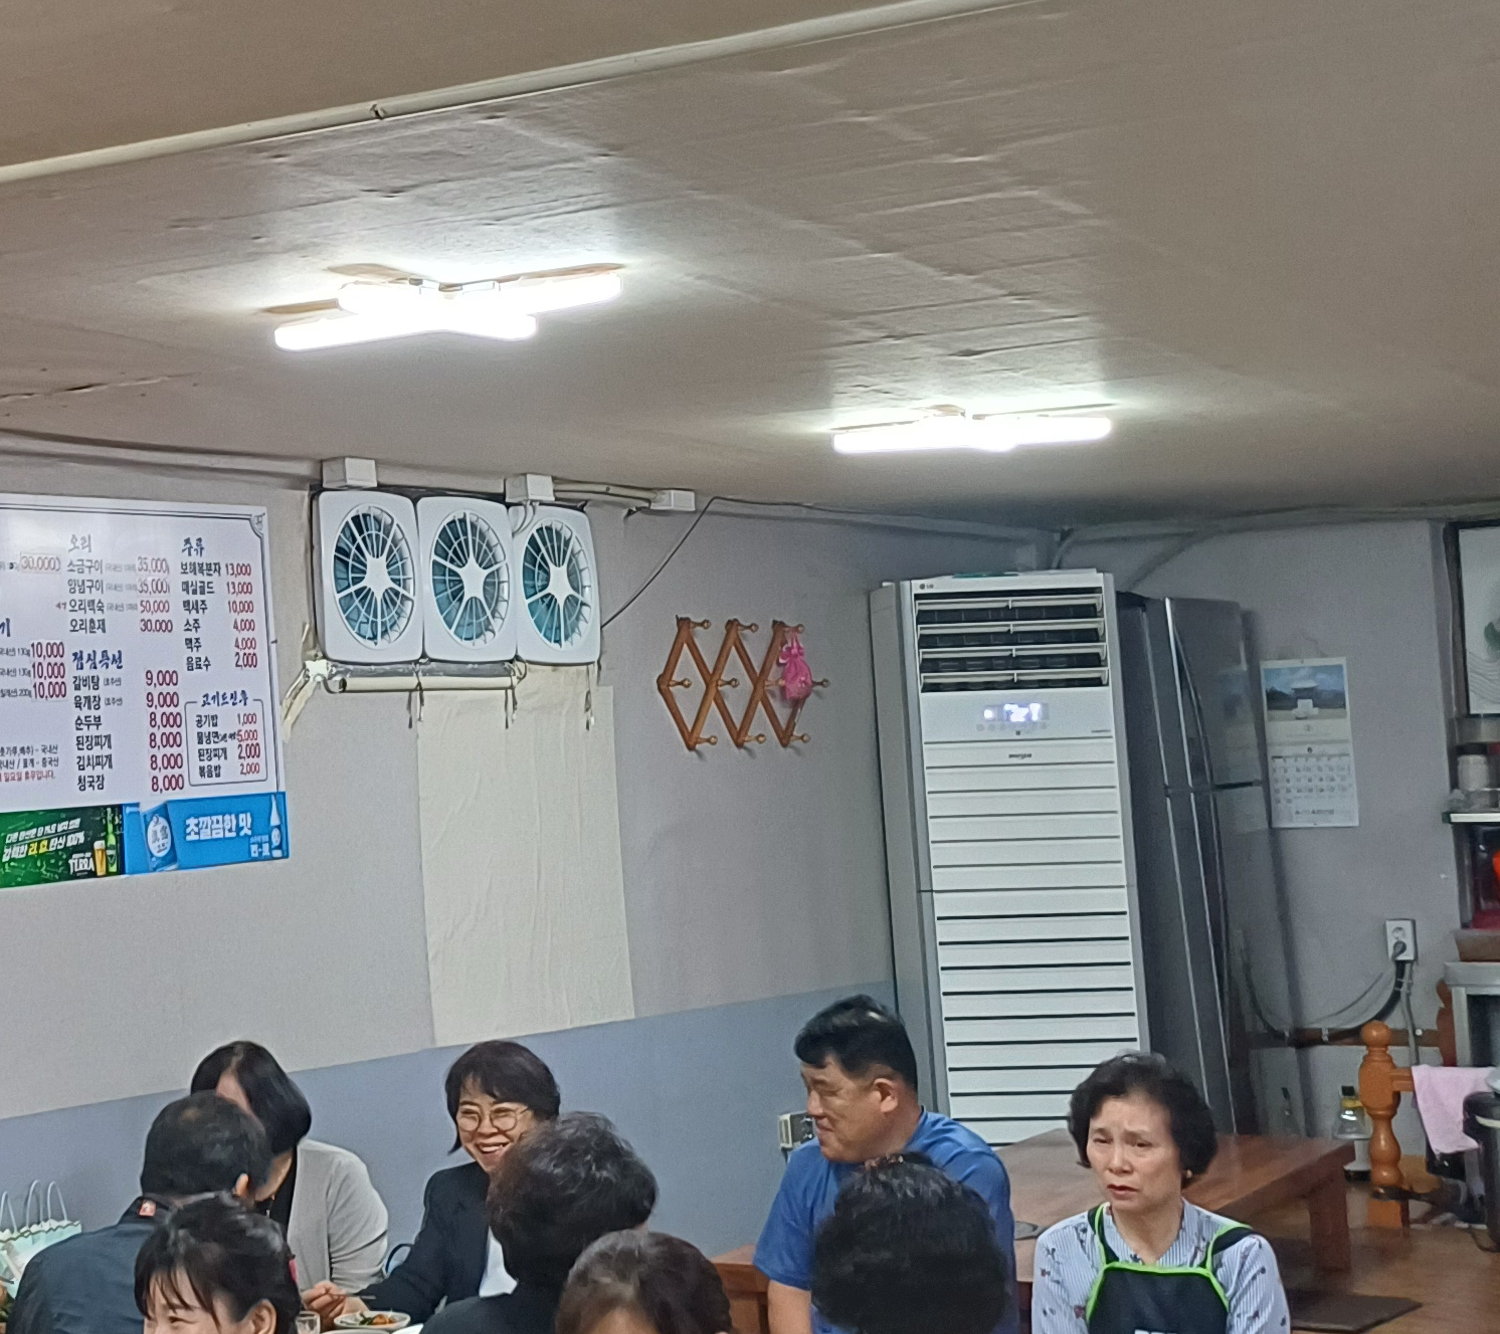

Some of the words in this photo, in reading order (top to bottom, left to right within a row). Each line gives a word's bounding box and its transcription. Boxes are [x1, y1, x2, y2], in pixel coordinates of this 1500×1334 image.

[68, 534, 92, 553] 오리
[182, 537, 205, 557] 주류
[67, 559, 103, 574] 소금구이
[225, 563, 251, 578] 13,000
[67, 578, 104, 594] 양념구이
[138, 577, 170, 595] 35,000
[226, 581, 253, 596] 13,000
[68, 598, 105, 614] 오리백숙
[140, 599, 170, 615] 50,000
[182, 600, 208, 615] 백세주
[228, 600, 254, 615] 10,000
[69, 618, 106, 633] 오리훈제
[183, 618, 201, 633] 소주
[233, 618, 255, 634] 4,000
[31, 641, 65, 660] 10,000
[184, 637, 202, 652] 맥주
[234, 637, 257, 651] 4,000
[72, 649, 123, 670] 점심특선
[186, 656, 211, 671] 음료수
[235, 652, 258, 669] 2,000
[32, 662, 66, 680] 10,000
[72, 675, 100, 691] 갈비탕
[145, 670, 178, 688] 9,000
[32, 681, 67, 700] 10,000
[74, 695, 101, 711] 육개장
[146, 691, 179, 709] 9,000
[75, 715, 102, 731] 순두부
[149, 712, 182, 730] 8,000
[195, 714, 218, 728] 공기밥
[237, 712, 257, 726] 1,000
[76, 734, 112, 751] 된장찌개
[149, 732, 182, 751] 8,000
[197, 731, 220, 745] 물냉면
[236, 729, 258, 742] 5,000
[197, 747, 227, 762] 된장찌개
[238, 742, 261, 760] 2,000
[76, 754, 113, 771] 김치찌개
[150, 753, 183, 772] 8,000
[198, 764, 221, 779] 볶음밥
[240, 762, 260, 776] 2,000
[77, 774, 105, 792] 청국장
[151, 774, 184, 794] 8,000
[185, 813, 237, 841] 초깔끔한
[239, 812, 252, 837] 맛
